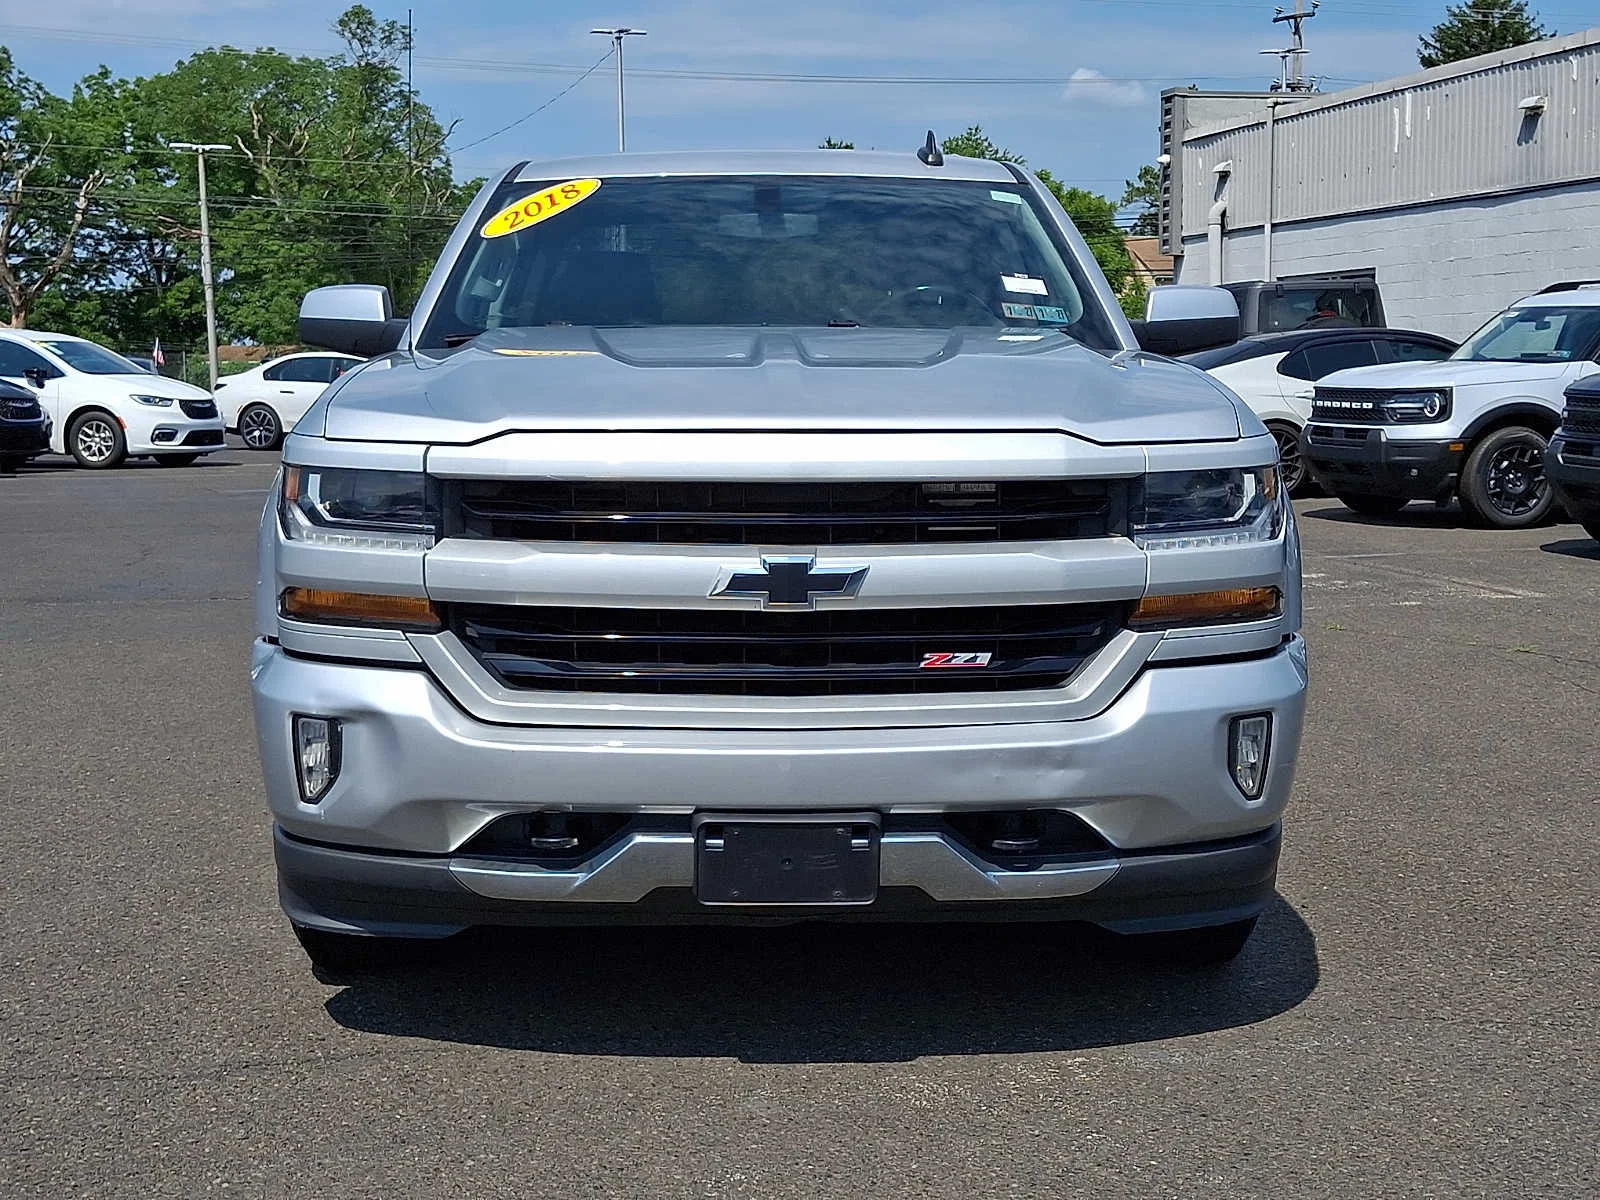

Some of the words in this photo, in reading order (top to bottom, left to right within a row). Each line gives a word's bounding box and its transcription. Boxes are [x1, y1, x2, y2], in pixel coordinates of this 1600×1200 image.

[504, 184, 581, 229] 2018
[1316, 400, 1373, 409] BRONCO
[919, 652, 992, 668] Z71
